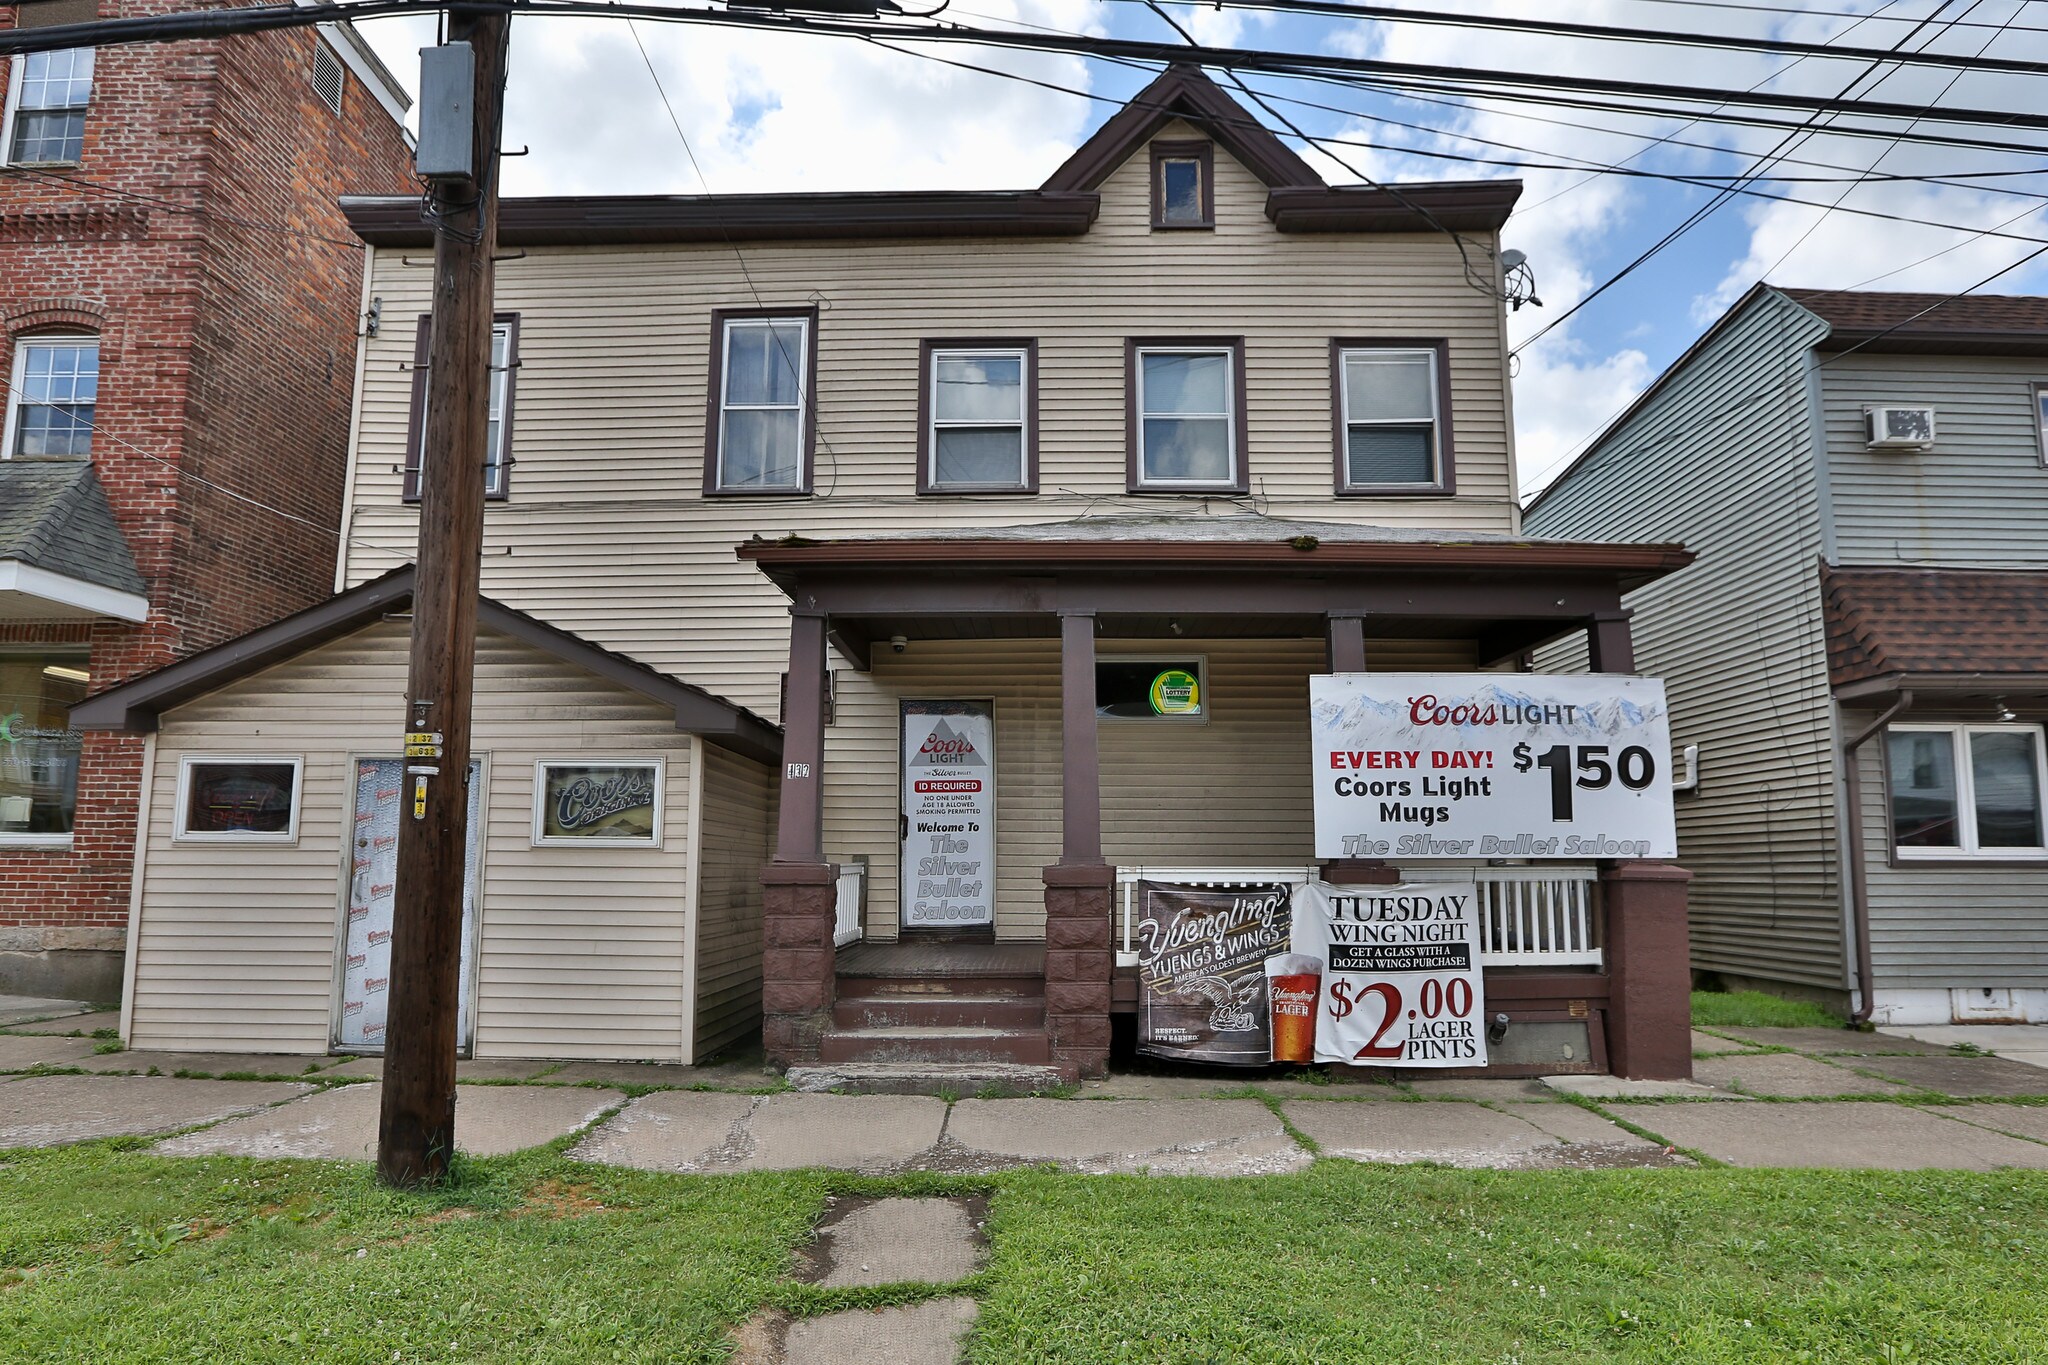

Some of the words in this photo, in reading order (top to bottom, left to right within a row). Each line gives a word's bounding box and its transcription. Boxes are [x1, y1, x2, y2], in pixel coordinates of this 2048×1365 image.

[1407, 694, 1499, 727] Coors
[1502, 704, 1577, 725] LIGHT
[920, 733, 975, 754] Coors
[930, 754, 965, 763] LIGHT
[1330, 750, 1421, 770] EVERY
[1431, 750, 1494, 769] DAY!
[931, 768, 957, 777] Silver
[931, 782, 978, 790] REQUIRED
[1334, 776, 1412, 797] Coors
[1422, 775, 1492, 802] Light
[556, 772, 652, 829] Coors
[1379, 802, 1450, 828] Mugs
[917, 822, 964, 833] Welcome
[968, 822, 980, 832] To
[930, 834, 969, 854] The
[1341, 835, 1390, 855] The
[1397, 834, 1474, 856] Silver
[1480, 834, 1559, 856] Bullet
[1564, 834, 1651, 856] Saloon
[918, 856, 980, 876] Silver
[917, 878, 982, 898] Bullet
[913, 900, 986, 921] Saloon
[1329, 895, 1468, 922] TUESDAY
[1138, 889, 1287, 966] Yuengling
[1329, 923, 1397, 943] WING
[1401, 922, 1468, 942] NIGHT
[1150, 946, 1212, 978] YUENGS
[1214, 945, 1226, 960] &
[1227, 924, 1280, 956] WINGS
[1350, 947, 1373, 957] GET
[1375, 947, 1386, 957] A
[1388, 947, 1415, 957] GLASS
[1416, 946, 1443, 956] WITH
[1443, 946, 1451, 955] A
[1173, 968, 1210, 984] AMERICA'S
[1209, 959, 1236, 973] OLDEST
[1236, 948, 1268, 966] BREWERY
[1333, 958, 1374, 968] DOZEN
[1376, 958, 1411, 968] WINGS
[1413, 956, 1466, 968] PURCHASE!
[1270, 987, 1316, 1002] Yuengling
[1276, 1005, 1309, 1016] LAGER
[1329, 977, 1473, 1060] $2.00
[1408, 1020, 1474, 1039] LAGER
[1407, 1039, 1476, 1060] PINTS
